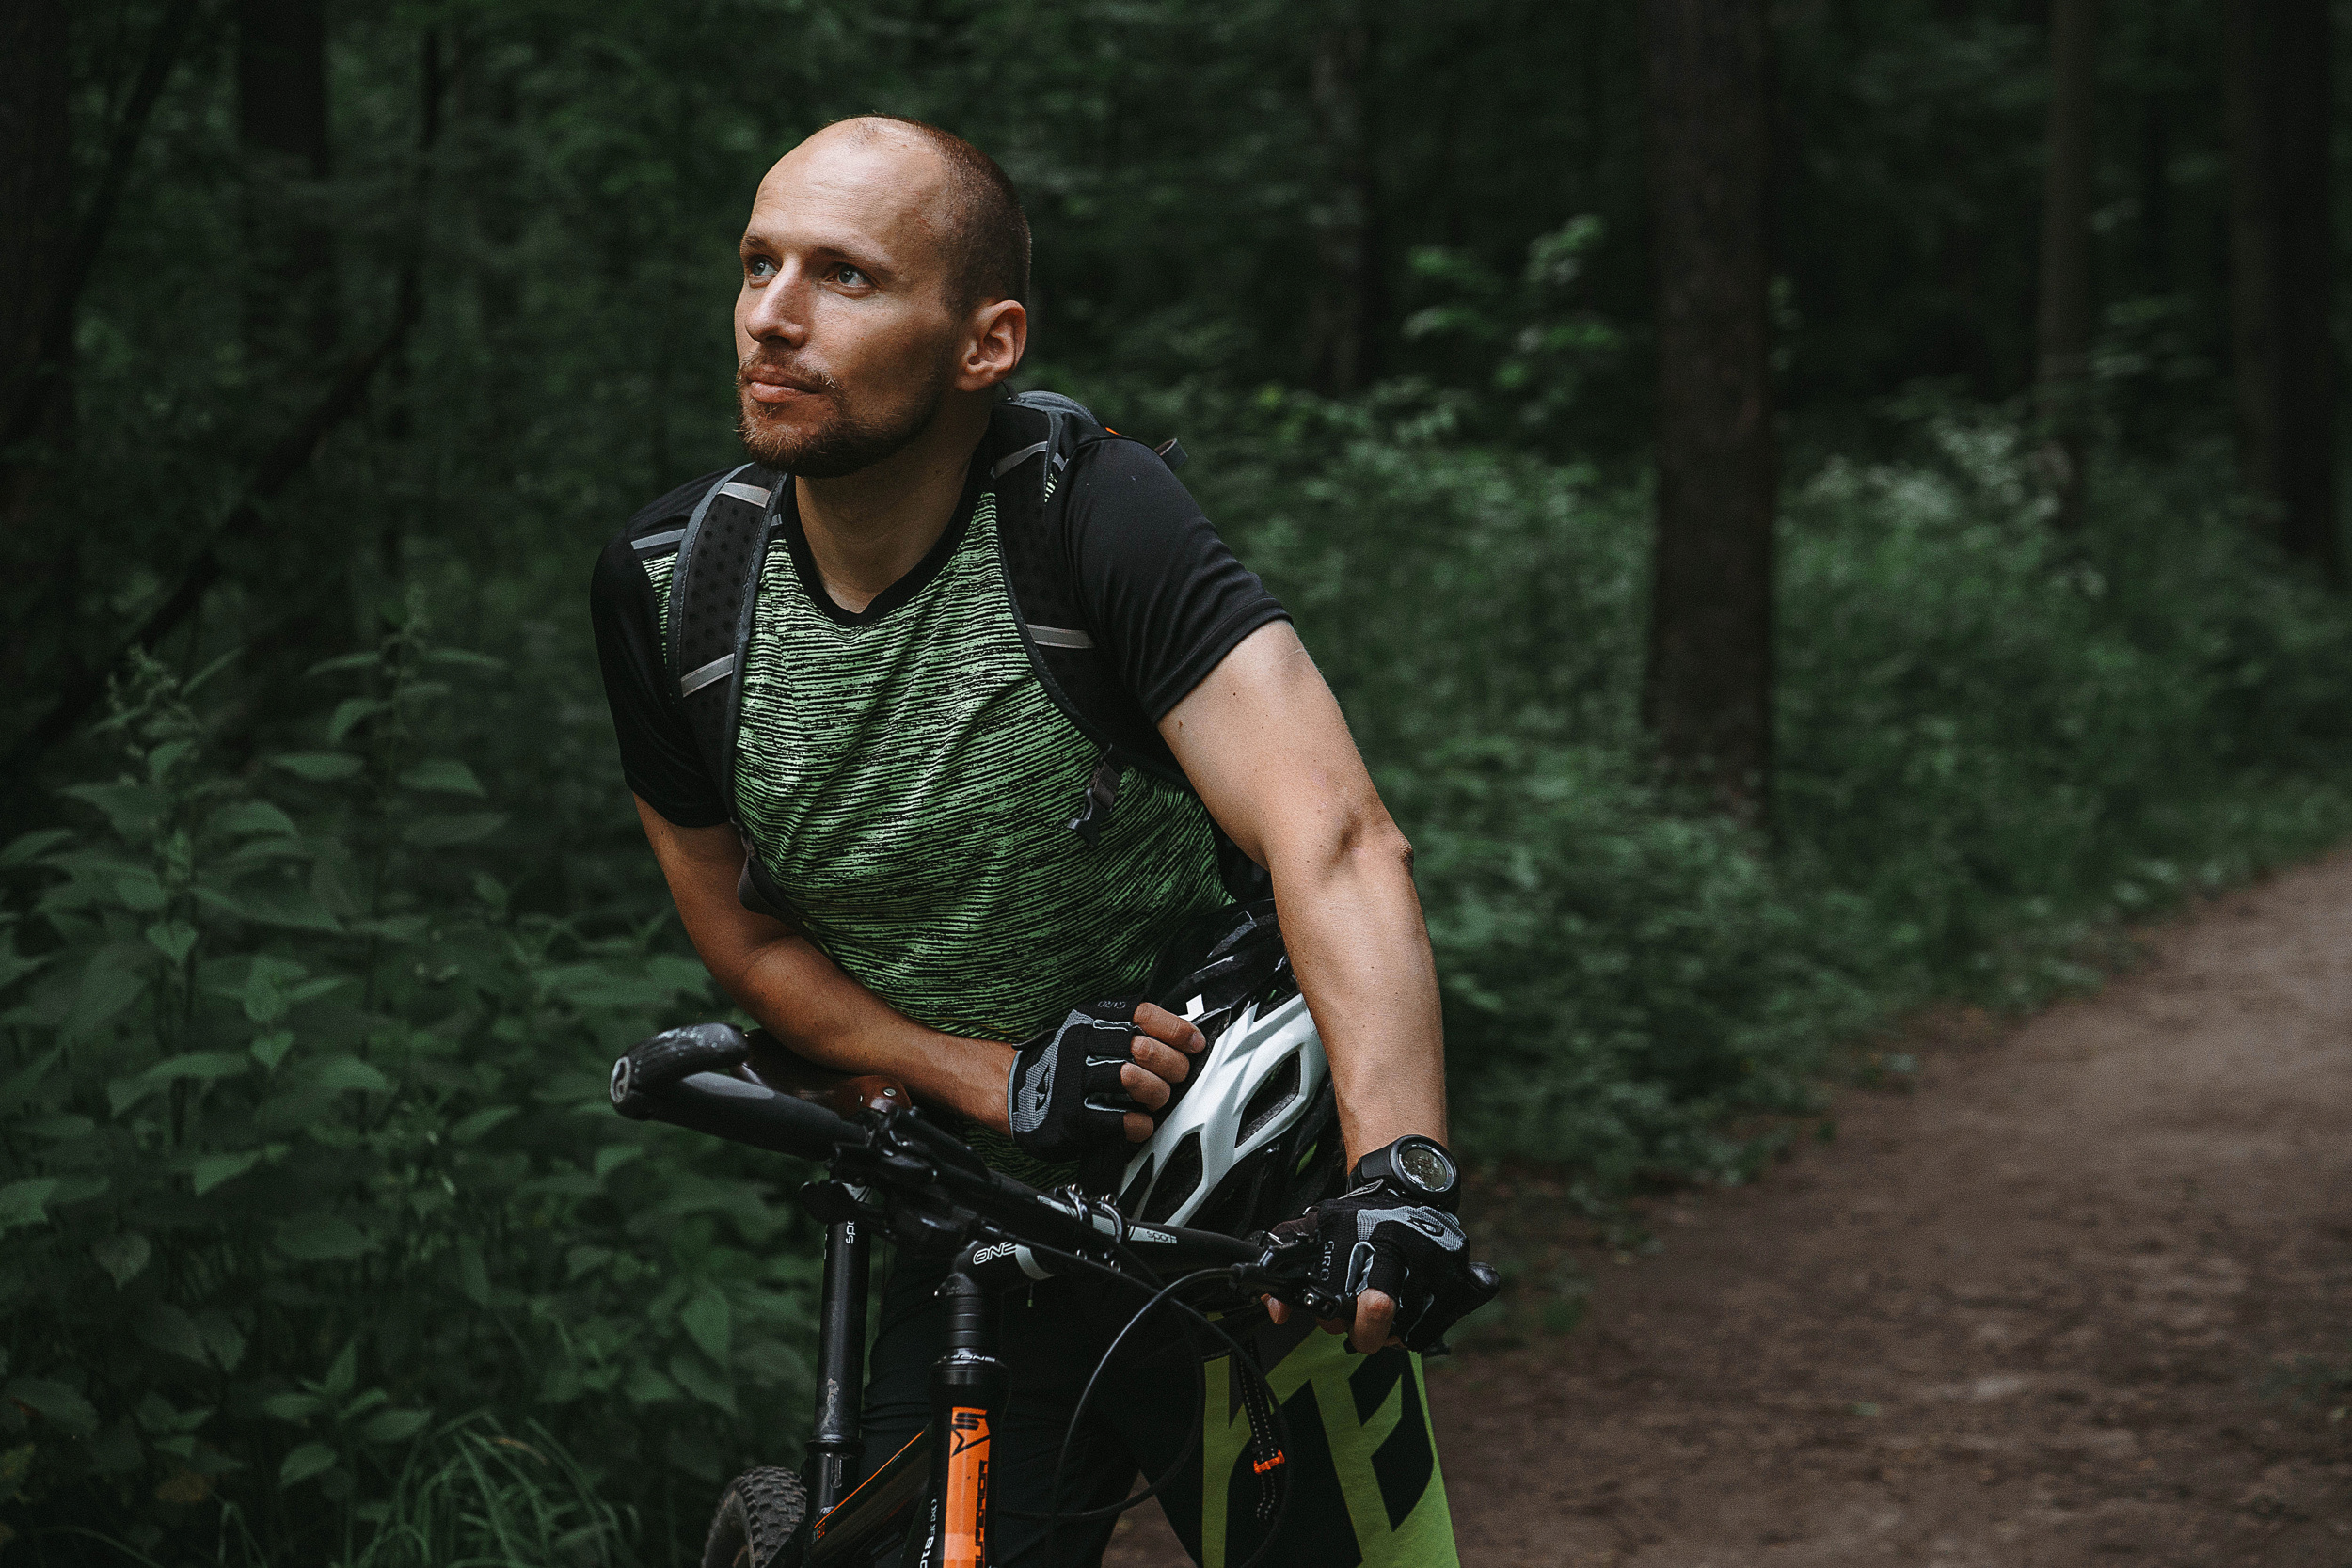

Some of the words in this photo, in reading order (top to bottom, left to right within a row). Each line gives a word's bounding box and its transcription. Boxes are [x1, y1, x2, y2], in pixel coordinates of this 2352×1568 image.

[1097, 1000, 1126, 1009] GIRO
[972, 1241, 1017, 1265] ONE
[1320, 1240, 1334, 1281] GIRO
